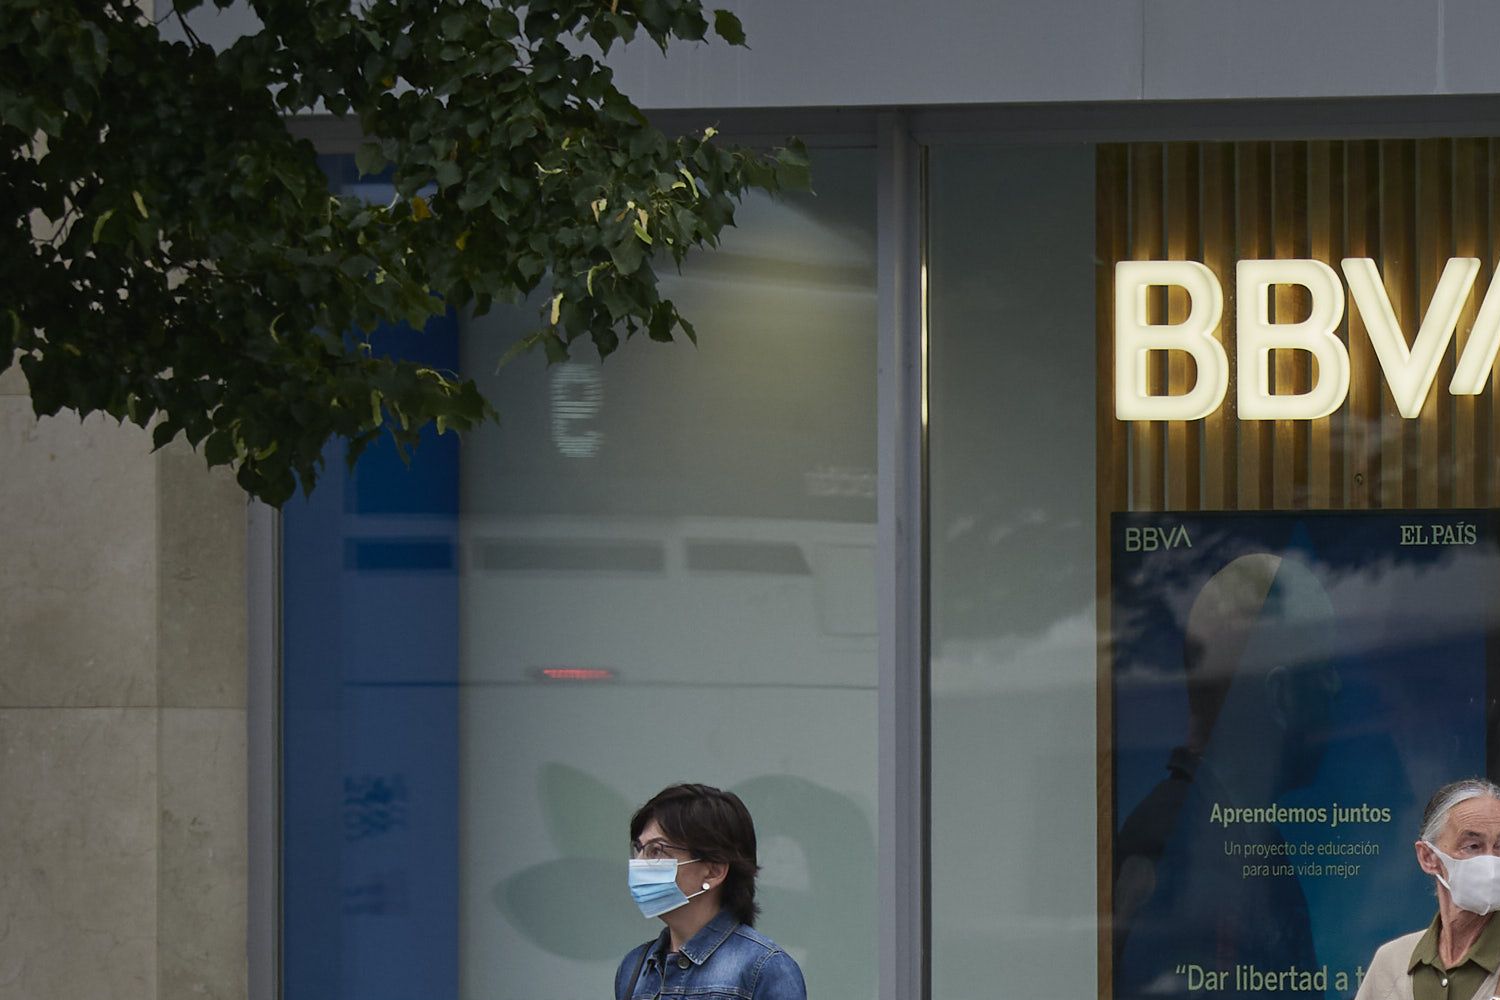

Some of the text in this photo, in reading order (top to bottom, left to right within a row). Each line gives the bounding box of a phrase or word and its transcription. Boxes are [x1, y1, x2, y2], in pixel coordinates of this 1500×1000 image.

[1125, 524, 1192, 551] BBVA
[1400, 521, 1477, 545] EL PAÍS
[1210, 802, 1391, 828] Aprendemos juntos
[1224, 841, 1379, 858] Un proyecto de educación
[1243, 862, 1361, 879] para una vida mejor
[1236, 965, 1328, 991] libertad
[1335, 971, 1348, 991] a
